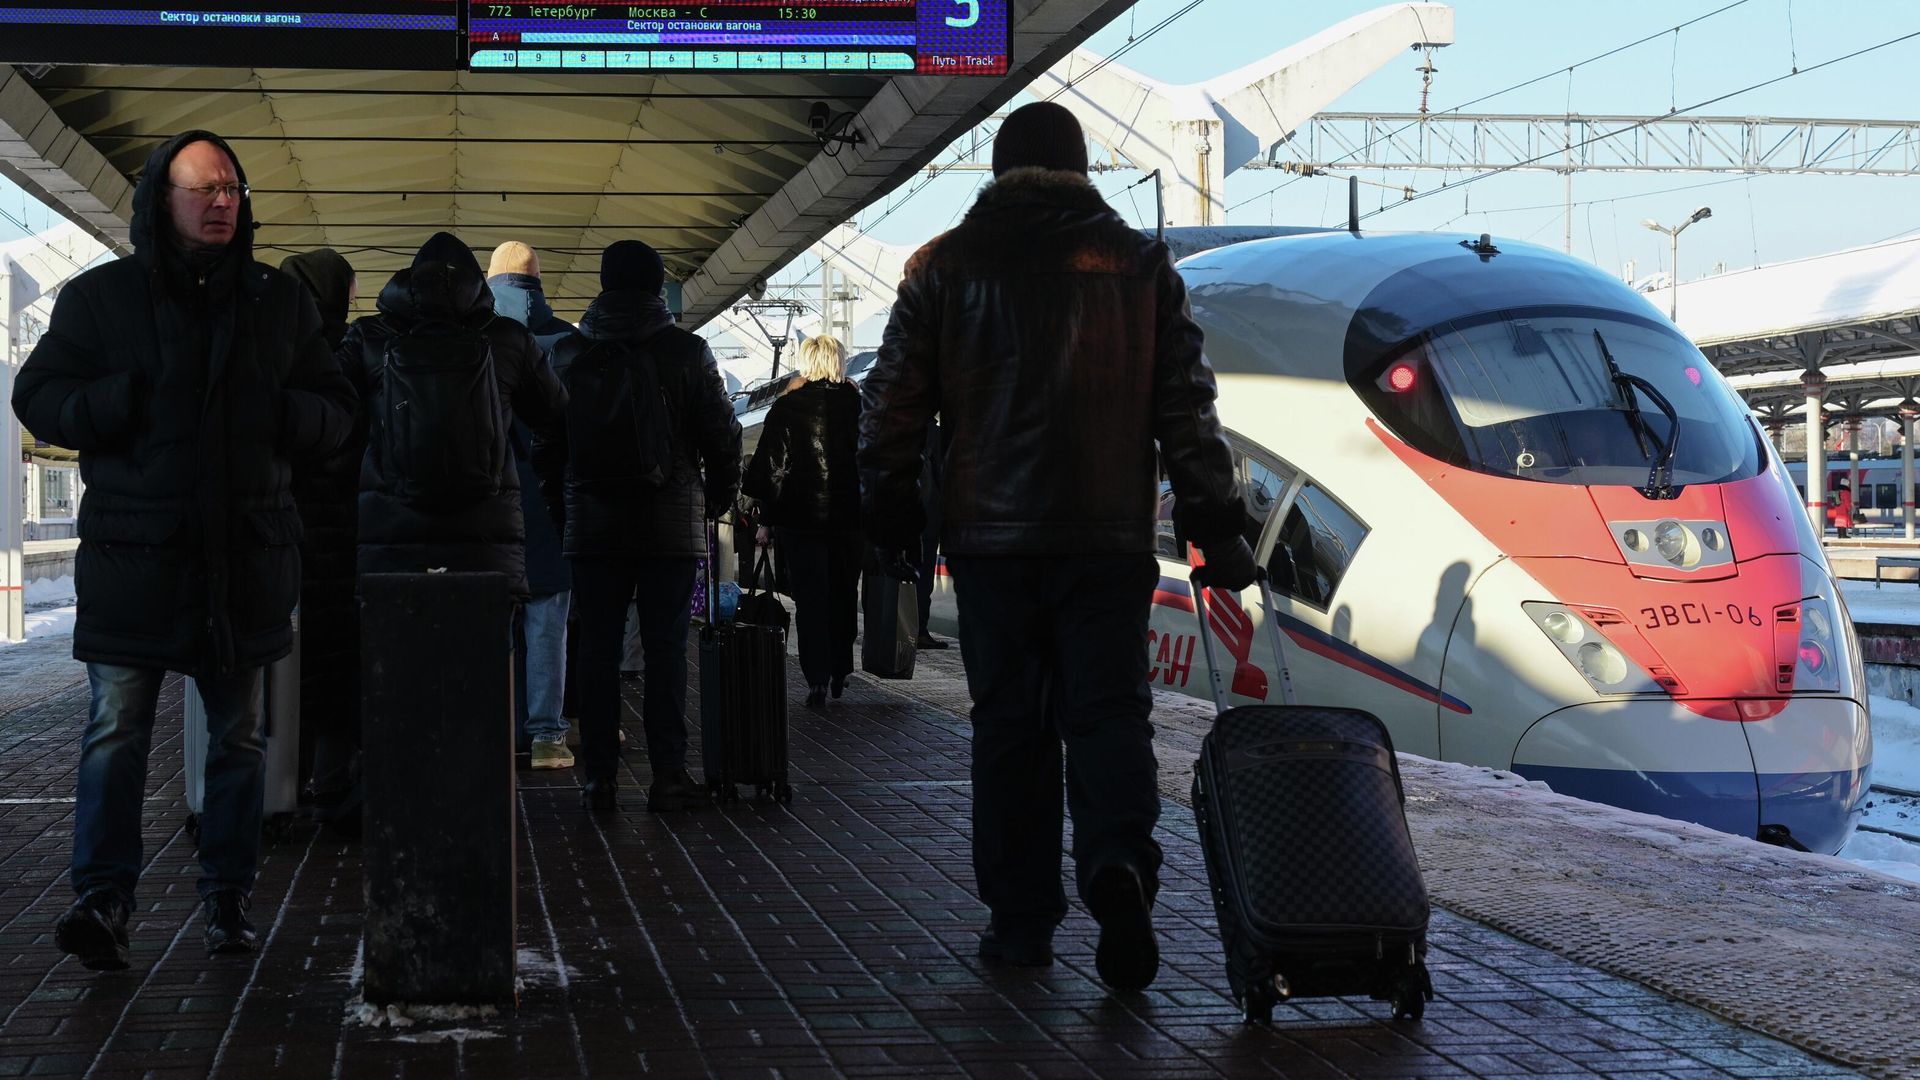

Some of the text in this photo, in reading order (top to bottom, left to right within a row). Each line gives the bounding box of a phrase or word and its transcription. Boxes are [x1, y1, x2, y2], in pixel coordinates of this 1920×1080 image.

[160, 11, 302, 24] Сектор остановки вагона
[488, 5, 512, 17] 772
[628, 6, 676, 18] Москва
[778, 8, 817, 19] 15:30
[627, 20, 762, 32] Сектор остановки вагона
[502, 53, 877, 64] 10 9 8 7 6 5 4 3 2 1
[932, 55, 995, 68] Путь Track
